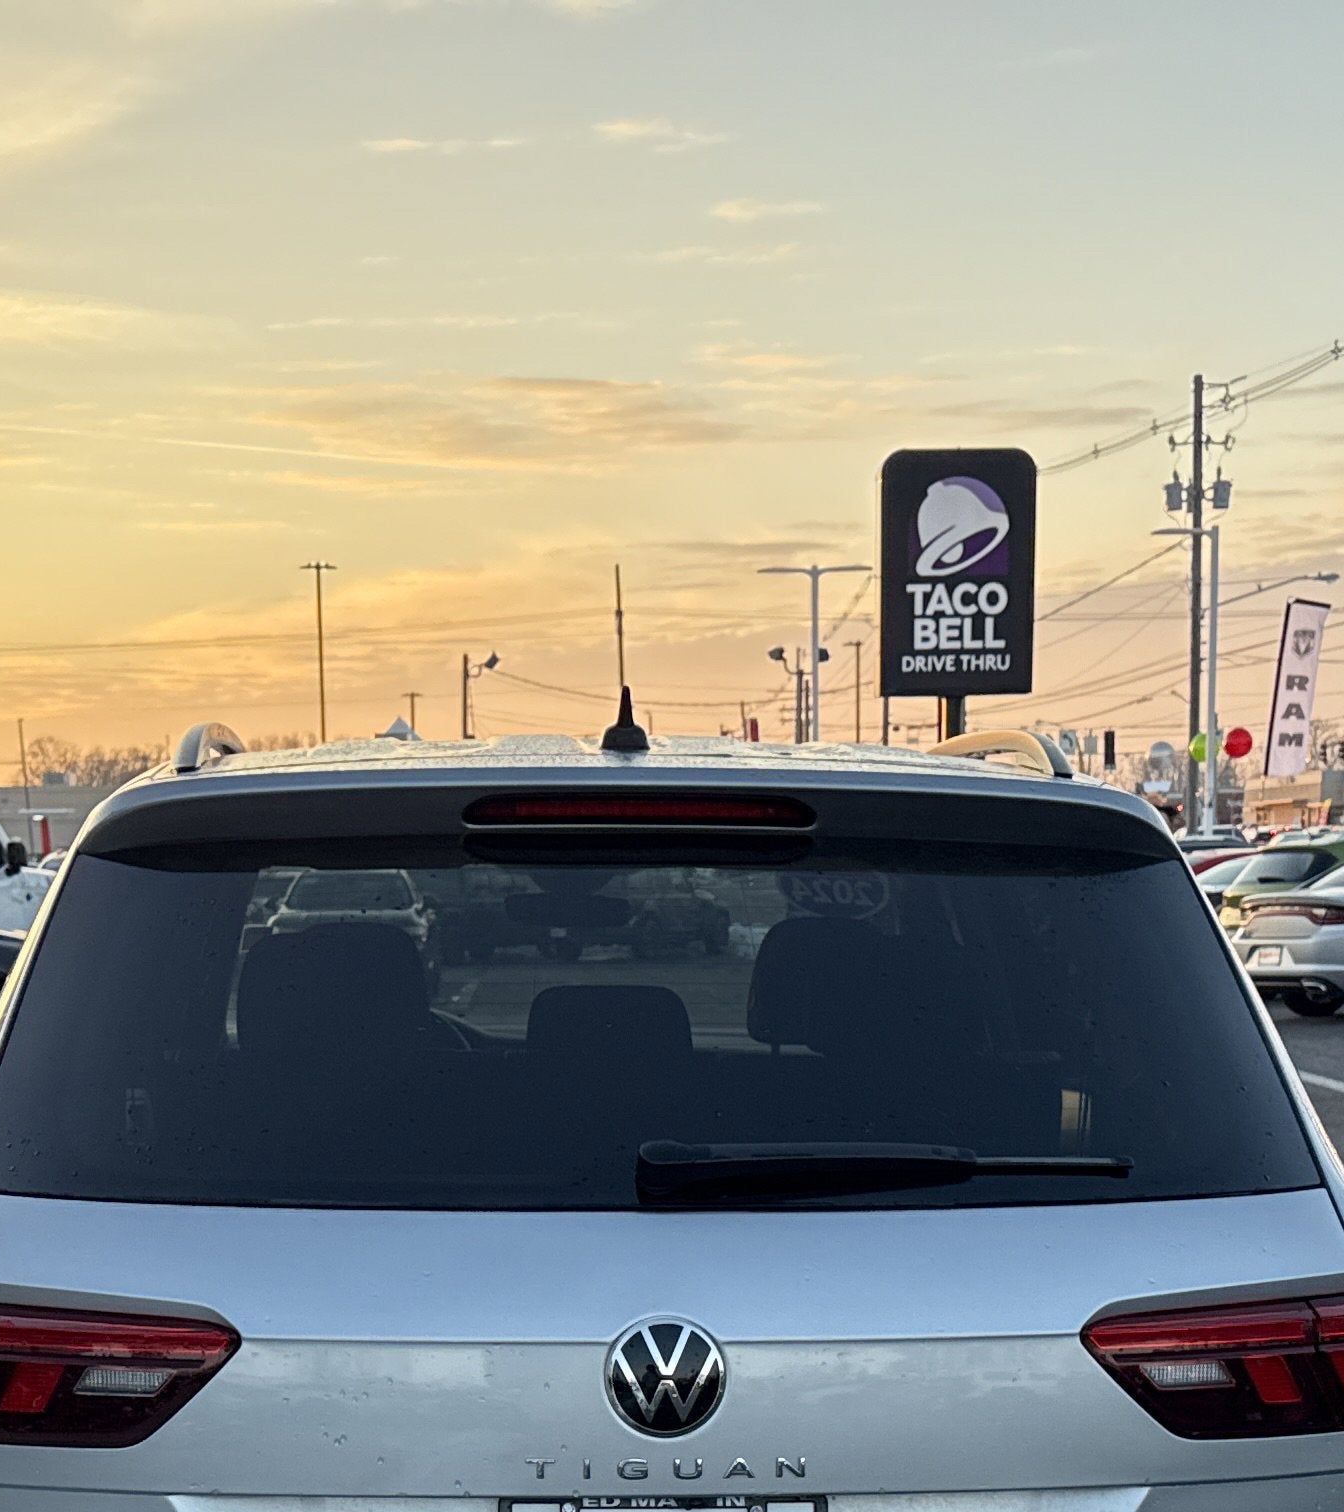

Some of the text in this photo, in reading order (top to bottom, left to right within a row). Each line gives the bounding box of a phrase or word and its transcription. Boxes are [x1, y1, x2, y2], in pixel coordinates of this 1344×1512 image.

[905, 582, 1009, 616] TACO
[913, 617, 1007, 650] BELL
[901, 654, 1011, 673] DRIVE THRU
[1278, 674, 1309, 747] RAM
[524, 1456, 807, 1481] TIGUAN
[630, 1496, 746, 1508] MAIN
